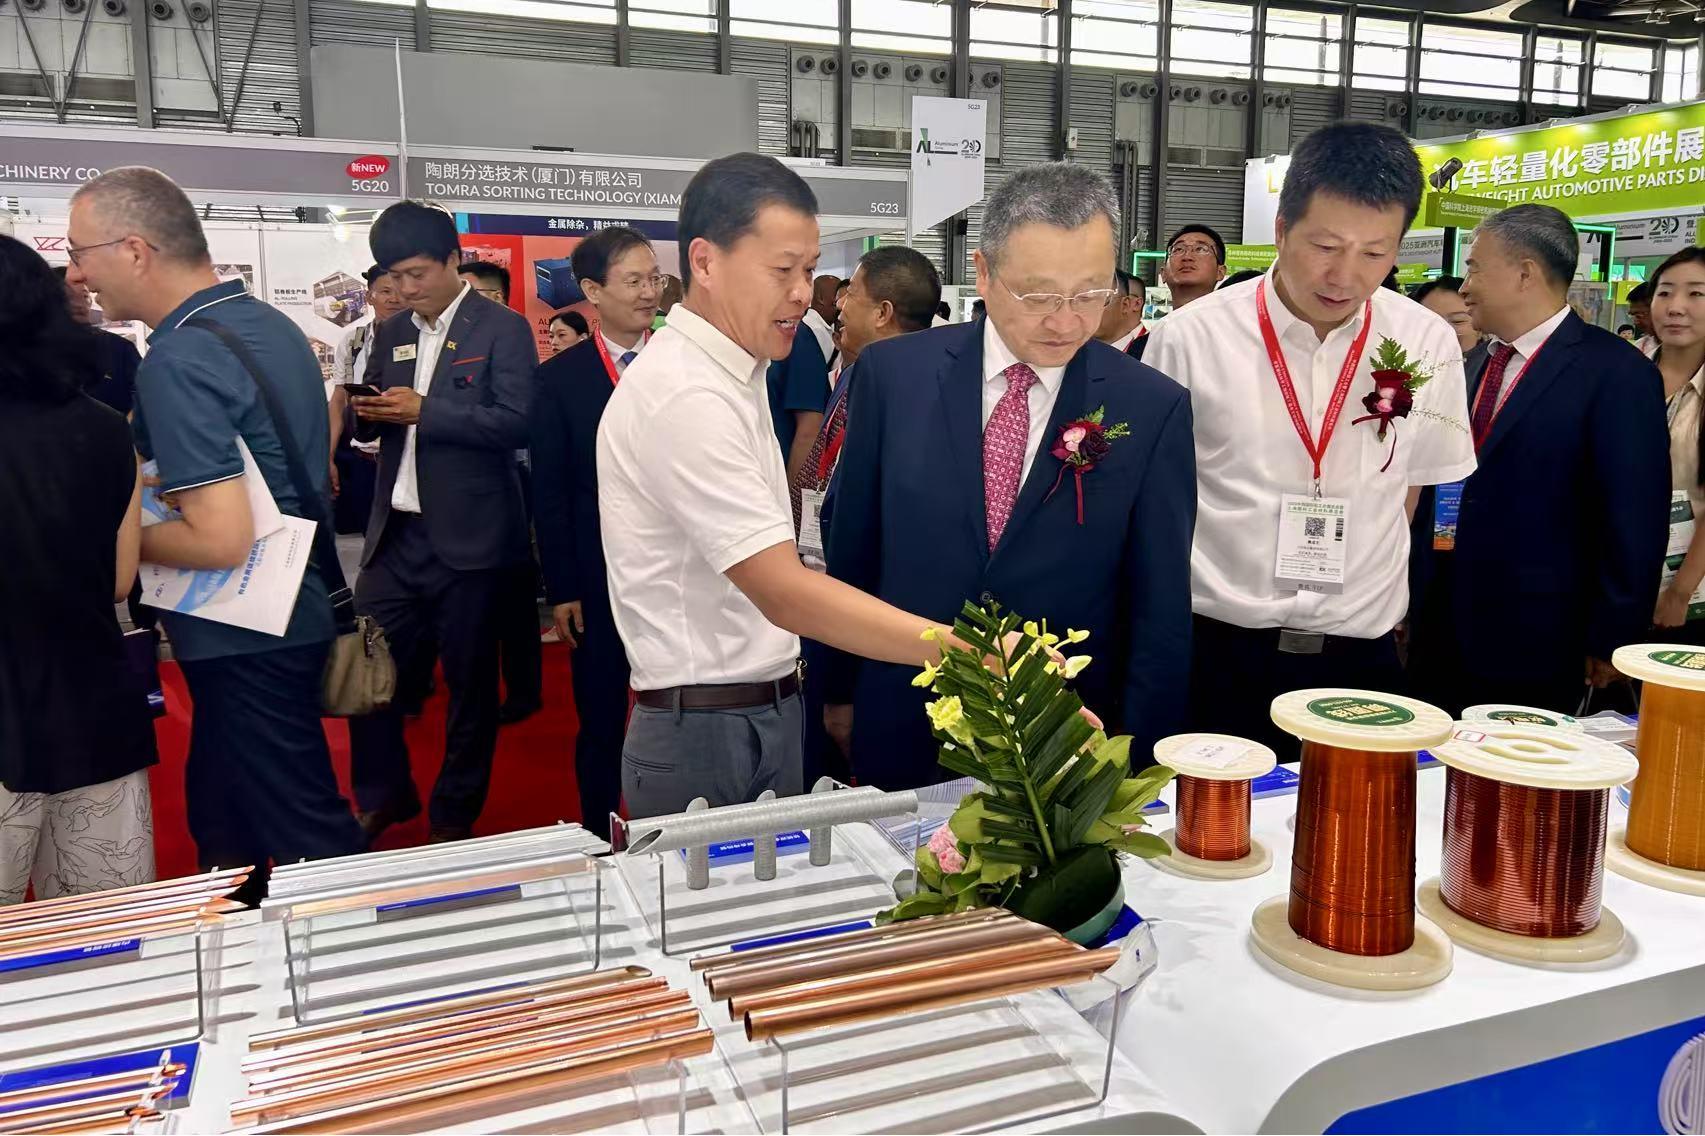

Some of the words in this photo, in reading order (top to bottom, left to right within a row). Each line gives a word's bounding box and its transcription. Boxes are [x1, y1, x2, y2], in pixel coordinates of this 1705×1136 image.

[1433, 126, 1705, 193] 车轻量化零部件展
[351, 179, 389, 193] 5G20
[425, 162, 642, 188] 陶朗分选技术(厦门)有限公司
[1531, 175, 1634, 201] AUTOMOTIVE
[1637, 169, 1686, 189] PARTS
[425, 182, 480, 197] TOMRA
[483, 185, 546, 200] SORTING
[548, 188, 642, 203] TECHNOLOGY
[644, 192, 681, 206] (XIAM
[870, 202, 899, 214] 5G23
